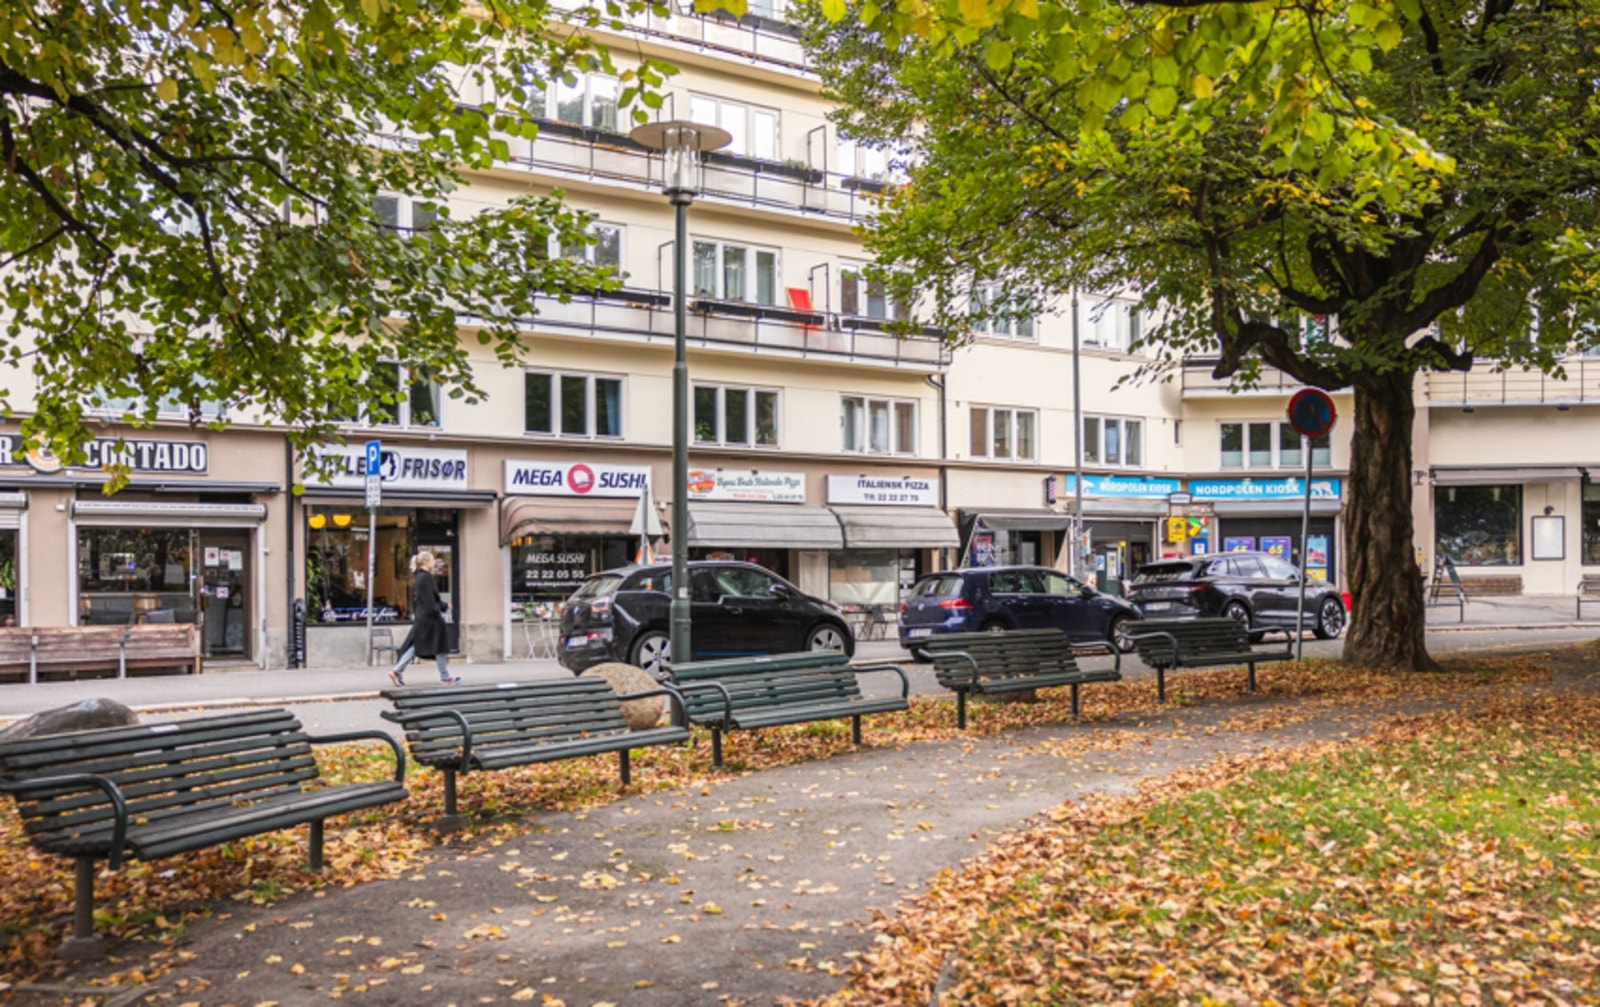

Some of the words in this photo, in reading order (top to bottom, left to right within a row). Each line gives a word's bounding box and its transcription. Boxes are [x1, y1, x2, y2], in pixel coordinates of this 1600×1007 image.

[369, 446, 377, 471] P
[402, 458, 466, 480] FRISØR
[513, 468, 562, 486] MEGA
[599, 472, 646, 488] SUSHI
[858, 480, 902, 489] ITALIENSK
[905, 482, 930, 490] PIZZA
[1266, 483, 1299, 494] KIOSK
[878, 493, 887, 501] 22
[1268, 544, 1283, 555] 65
[525, 553, 555, 563] MEGA
[557, 553, 585, 563] SUSHI
[526, 570, 539, 579] 22
[541, 570, 554, 579] 22
[556, 570, 569, 579] 05
[572, 570, 585, 579] 55
